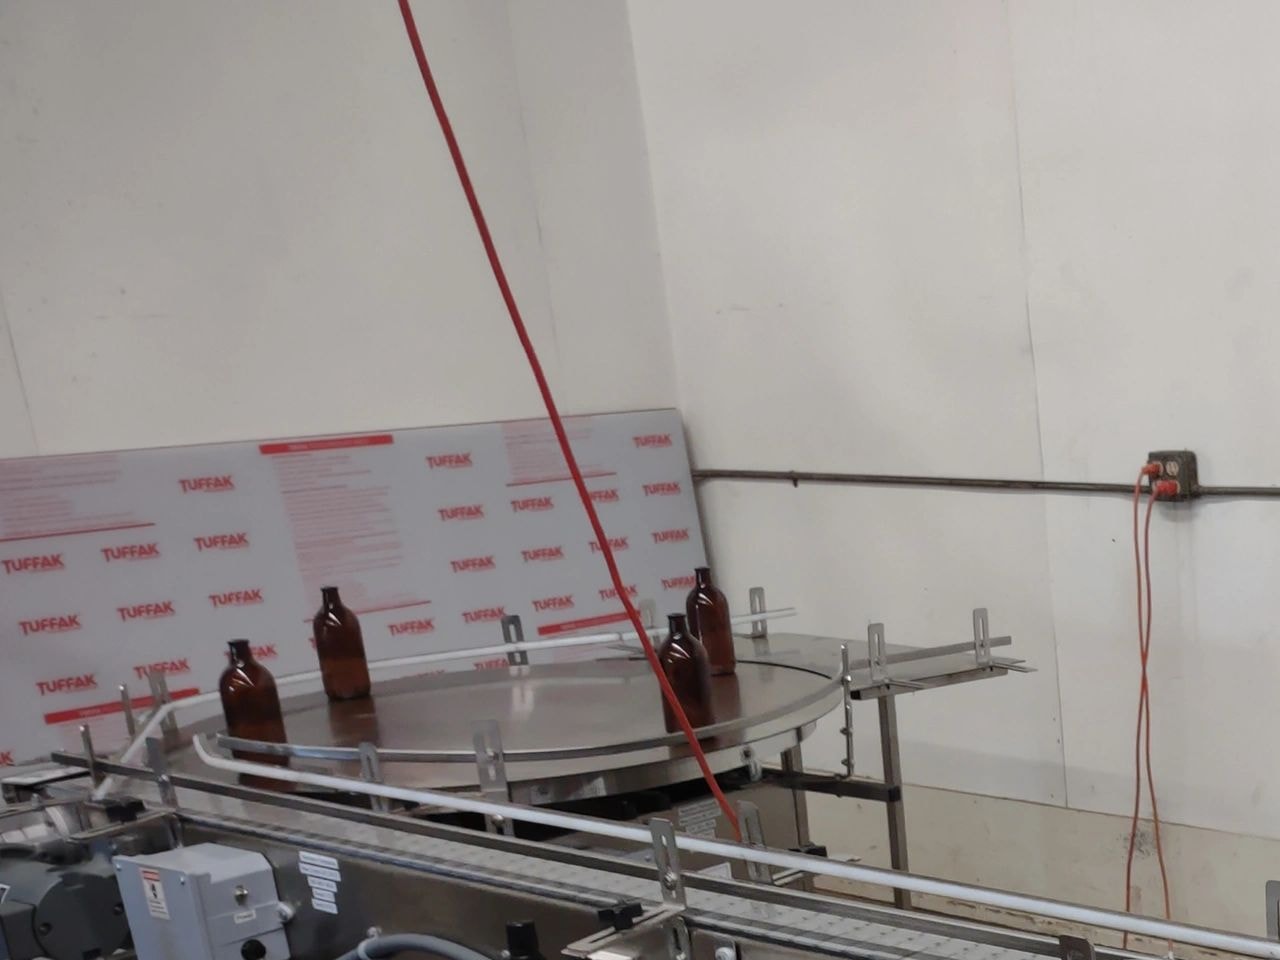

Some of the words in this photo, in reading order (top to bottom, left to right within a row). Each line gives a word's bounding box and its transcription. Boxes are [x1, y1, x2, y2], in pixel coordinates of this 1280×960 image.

[633, 433, 673, 448] TUFFAK
[426, 453, 472, 469] TUFFAK
[179, 474, 235, 492] TUFFAK
[642, 482, 681, 496] TUFFAK
[438, 504, 485, 521] TUFFAK
[511, 496, 554, 512] TUFFAK
[194, 532, 248, 551] TUFFAK
[588, 536, 629, 553] TUFAK
[652, 528, 689, 544] TUFFAK
[102, 543, 160, 562] TUFFAK
[521, 546, 564, 562] TUFFAK
[1, 553, 65, 574] TUFFAK
[451, 555, 496, 573] TUFFAK
[209, 588, 263, 607] TUFFAK
[598, 584, 638, 600] TUFAK
[117, 600, 175, 621] TUFFAK
[532, 594, 574, 612] TUFFAK
[19, 613, 81, 635] TUFFAK
[388, 618, 435, 636] TUFFAK
[133, 658, 191, 679] TUFFAK
[36, 673, 97, 695] TUFFAK
